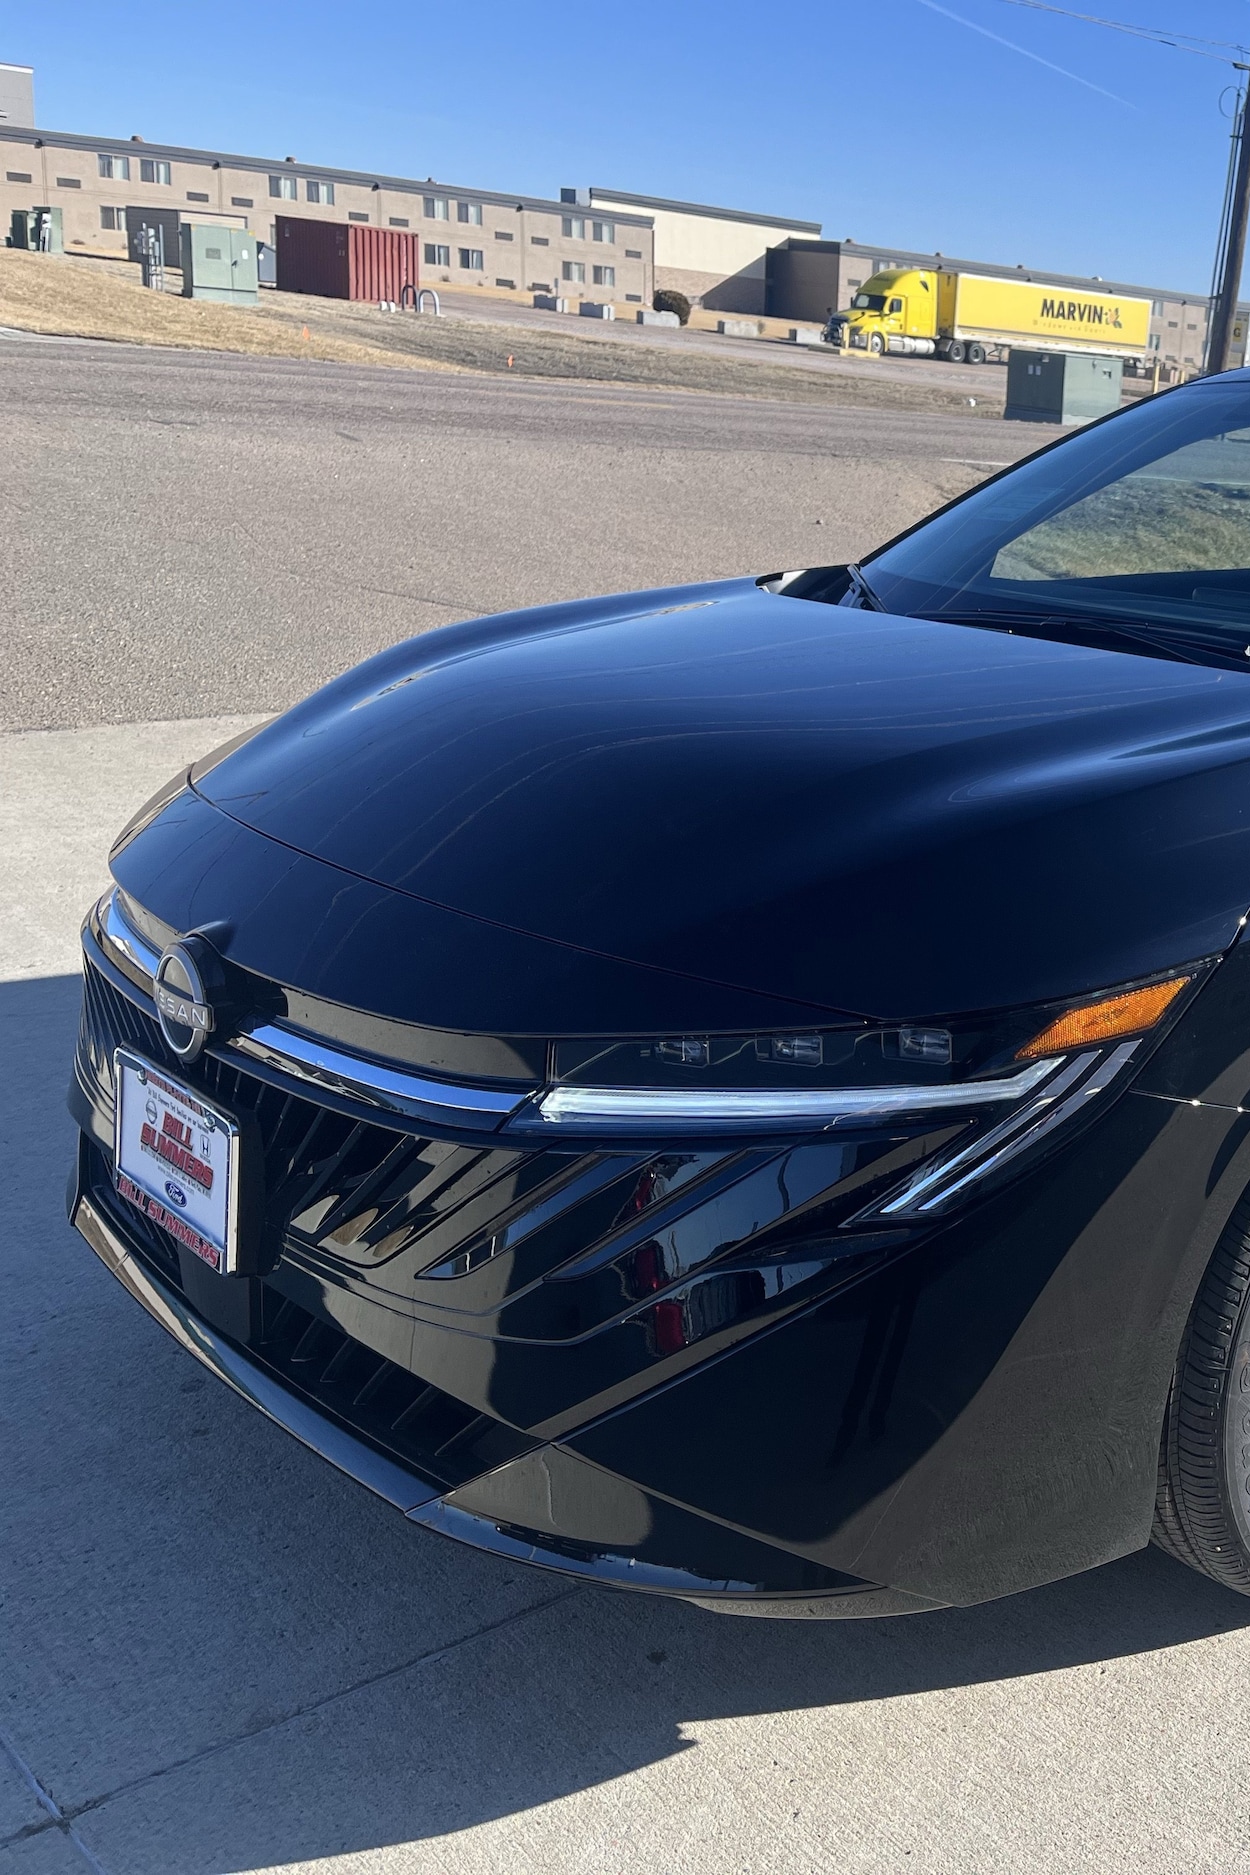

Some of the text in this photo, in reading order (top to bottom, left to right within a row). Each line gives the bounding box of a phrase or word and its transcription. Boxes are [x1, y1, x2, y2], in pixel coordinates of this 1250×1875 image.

[1041, 298, 1103, 324] MARVIN
[140, 1121, 214, 1190] SUMMERS
[162, 1110, 193, 1151] BILL
[117, 1175, 219, 1268] BILL SUMMERS
